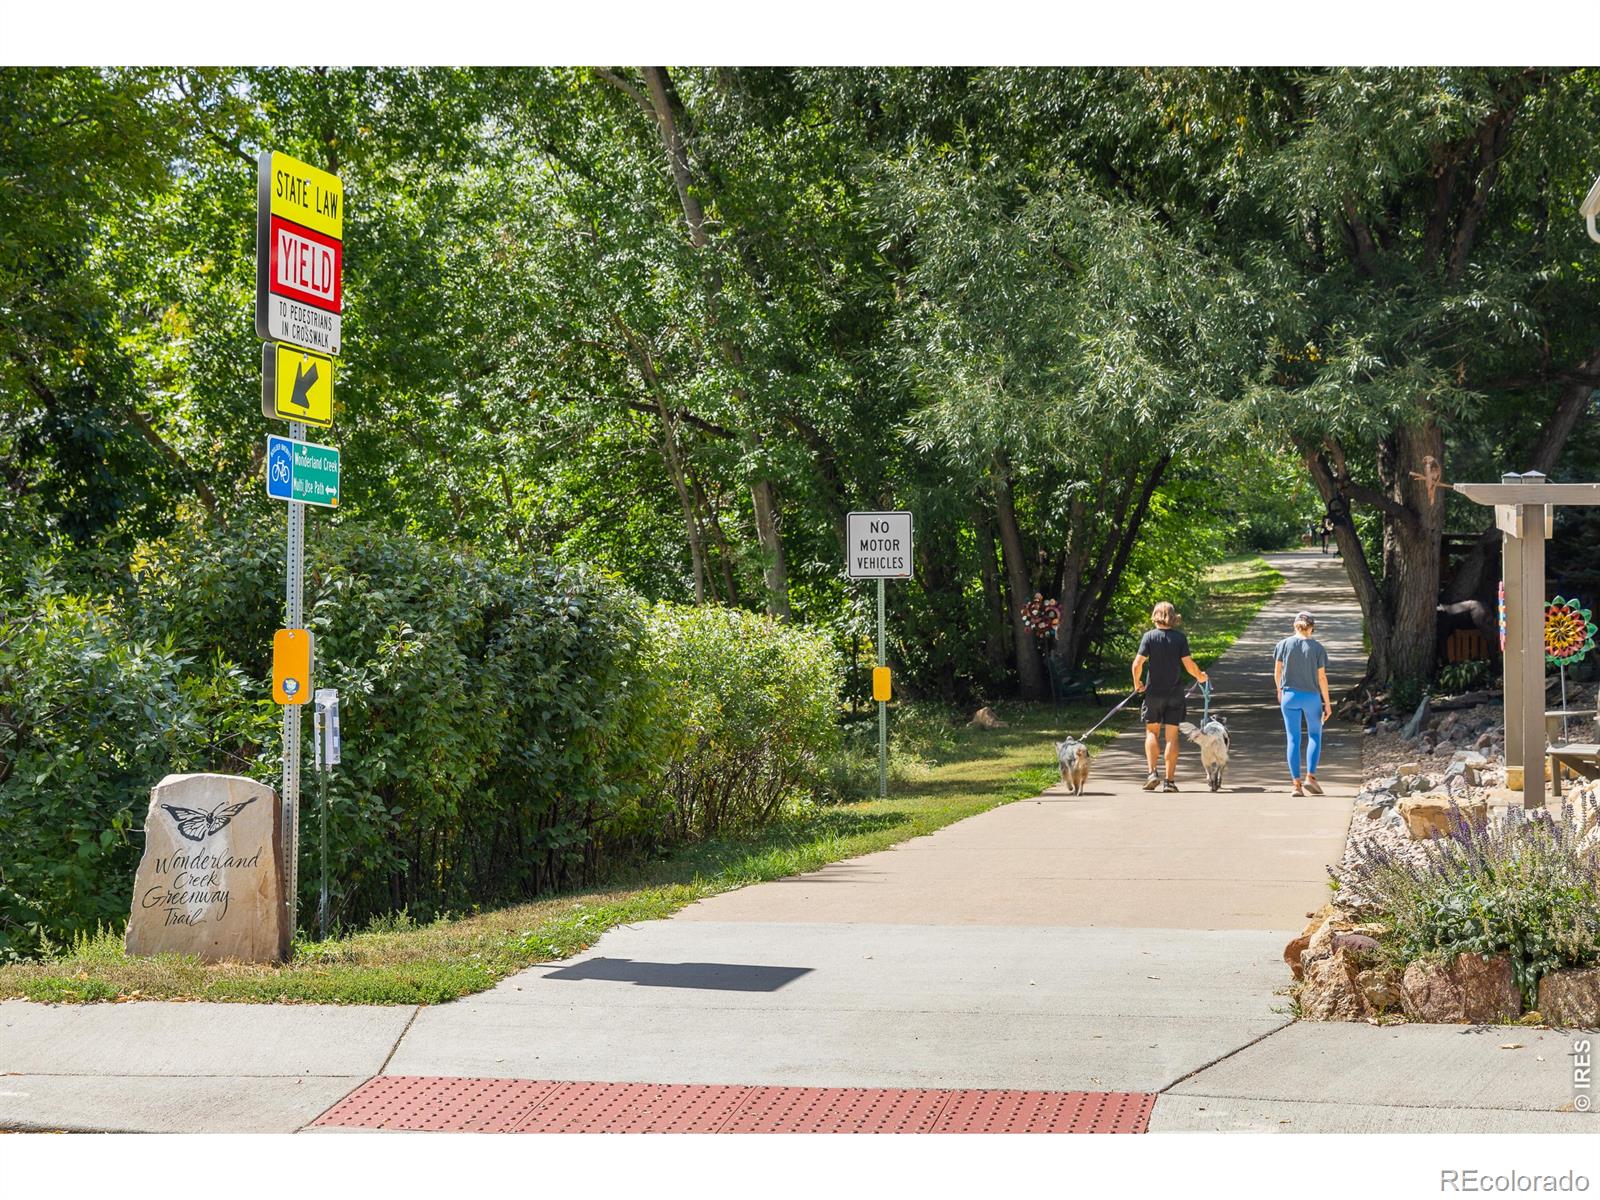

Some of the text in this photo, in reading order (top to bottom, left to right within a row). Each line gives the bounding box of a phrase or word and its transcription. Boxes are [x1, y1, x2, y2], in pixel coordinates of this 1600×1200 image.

[277, 170, 338, 220] STATE LAW
[282, 235, 331, 294] YIELD
[279, 301, 332, 331] TO PEDESTRIANS
[281, 320, 329, 348] IN CROSSWALK
[294, 452, 322, 470] Wonderland
[323, 457, 338, 473] Creek
[314, 480, 325, 495] Path
[870, 521, 889, 534] NO
[860, 539, 900, 552] MOTOR
[857, 557, 904, 569] VEHICLES
[156, 848, 263, 873] Wonderland
[173, 870, 219, 889] Creek
[142, 886, 234, 921] Greenway
[164, 908, 206, 927] Trail
